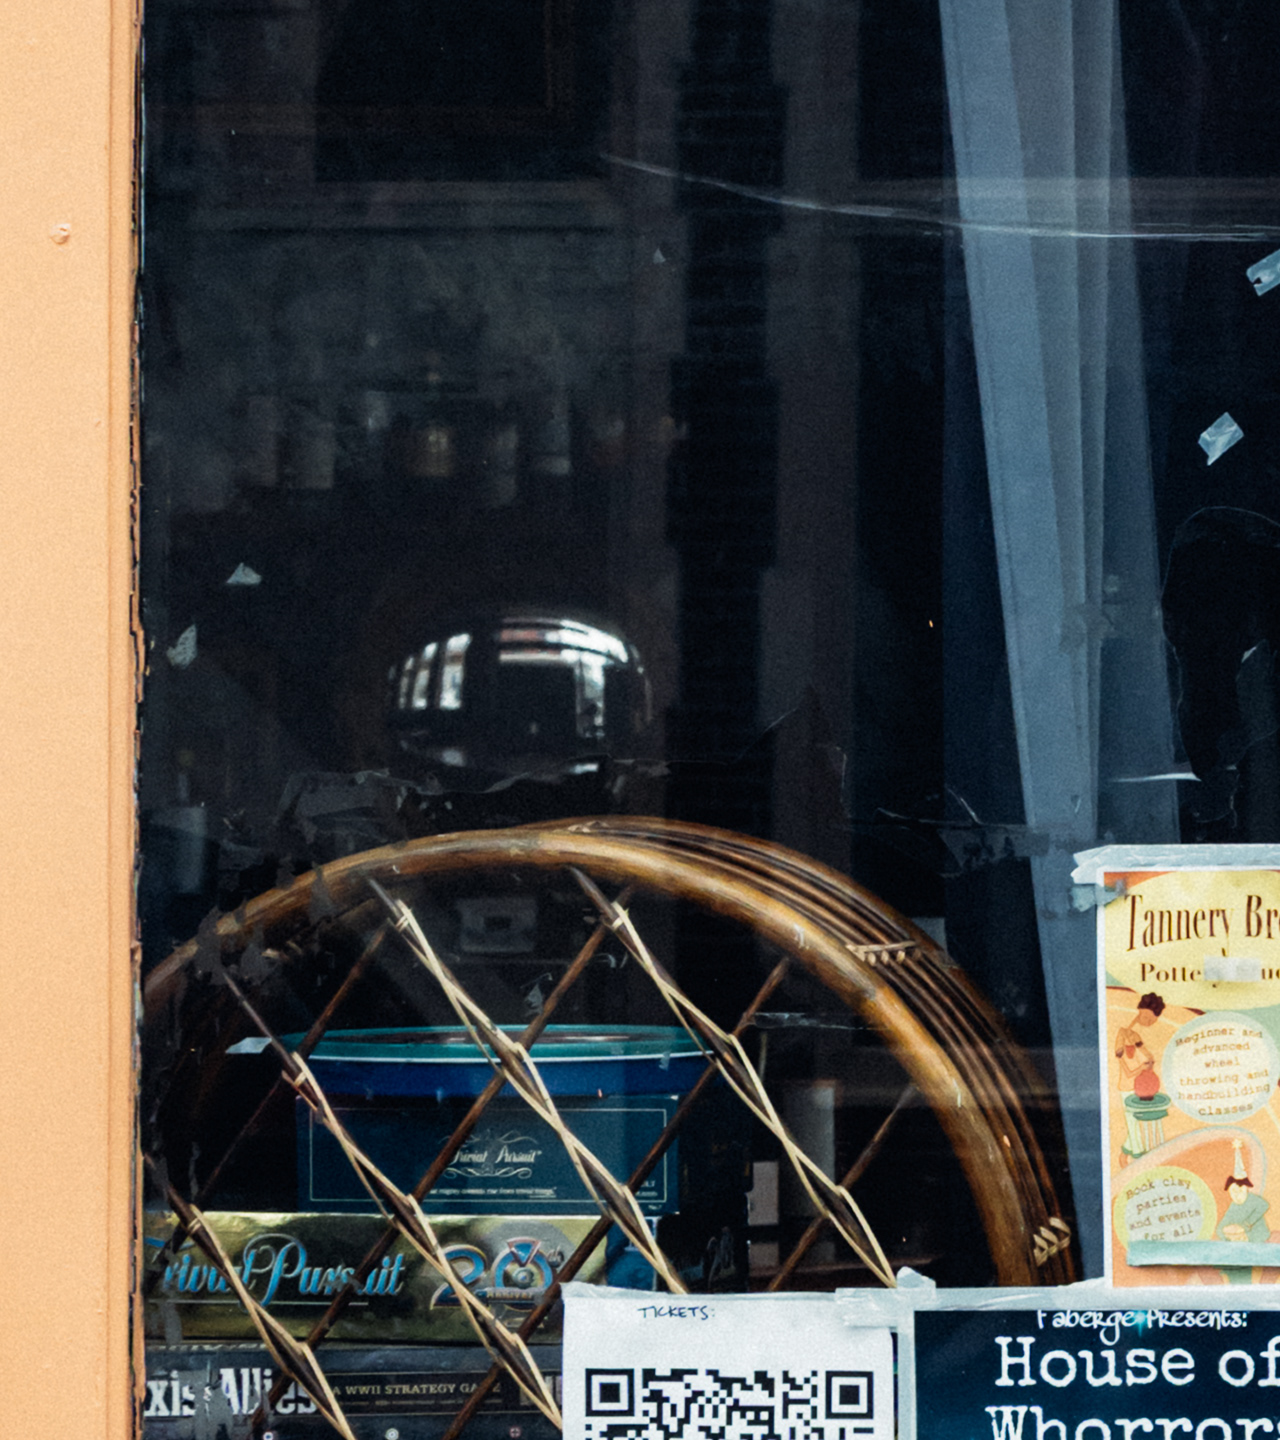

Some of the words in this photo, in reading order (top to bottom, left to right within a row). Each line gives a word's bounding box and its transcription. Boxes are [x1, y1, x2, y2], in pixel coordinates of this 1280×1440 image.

[1126, 895, 1233, 956] Tannery
[637, 1306, 715, 1320] TICKETS:
[995, 1336, 1194, 1387] House
